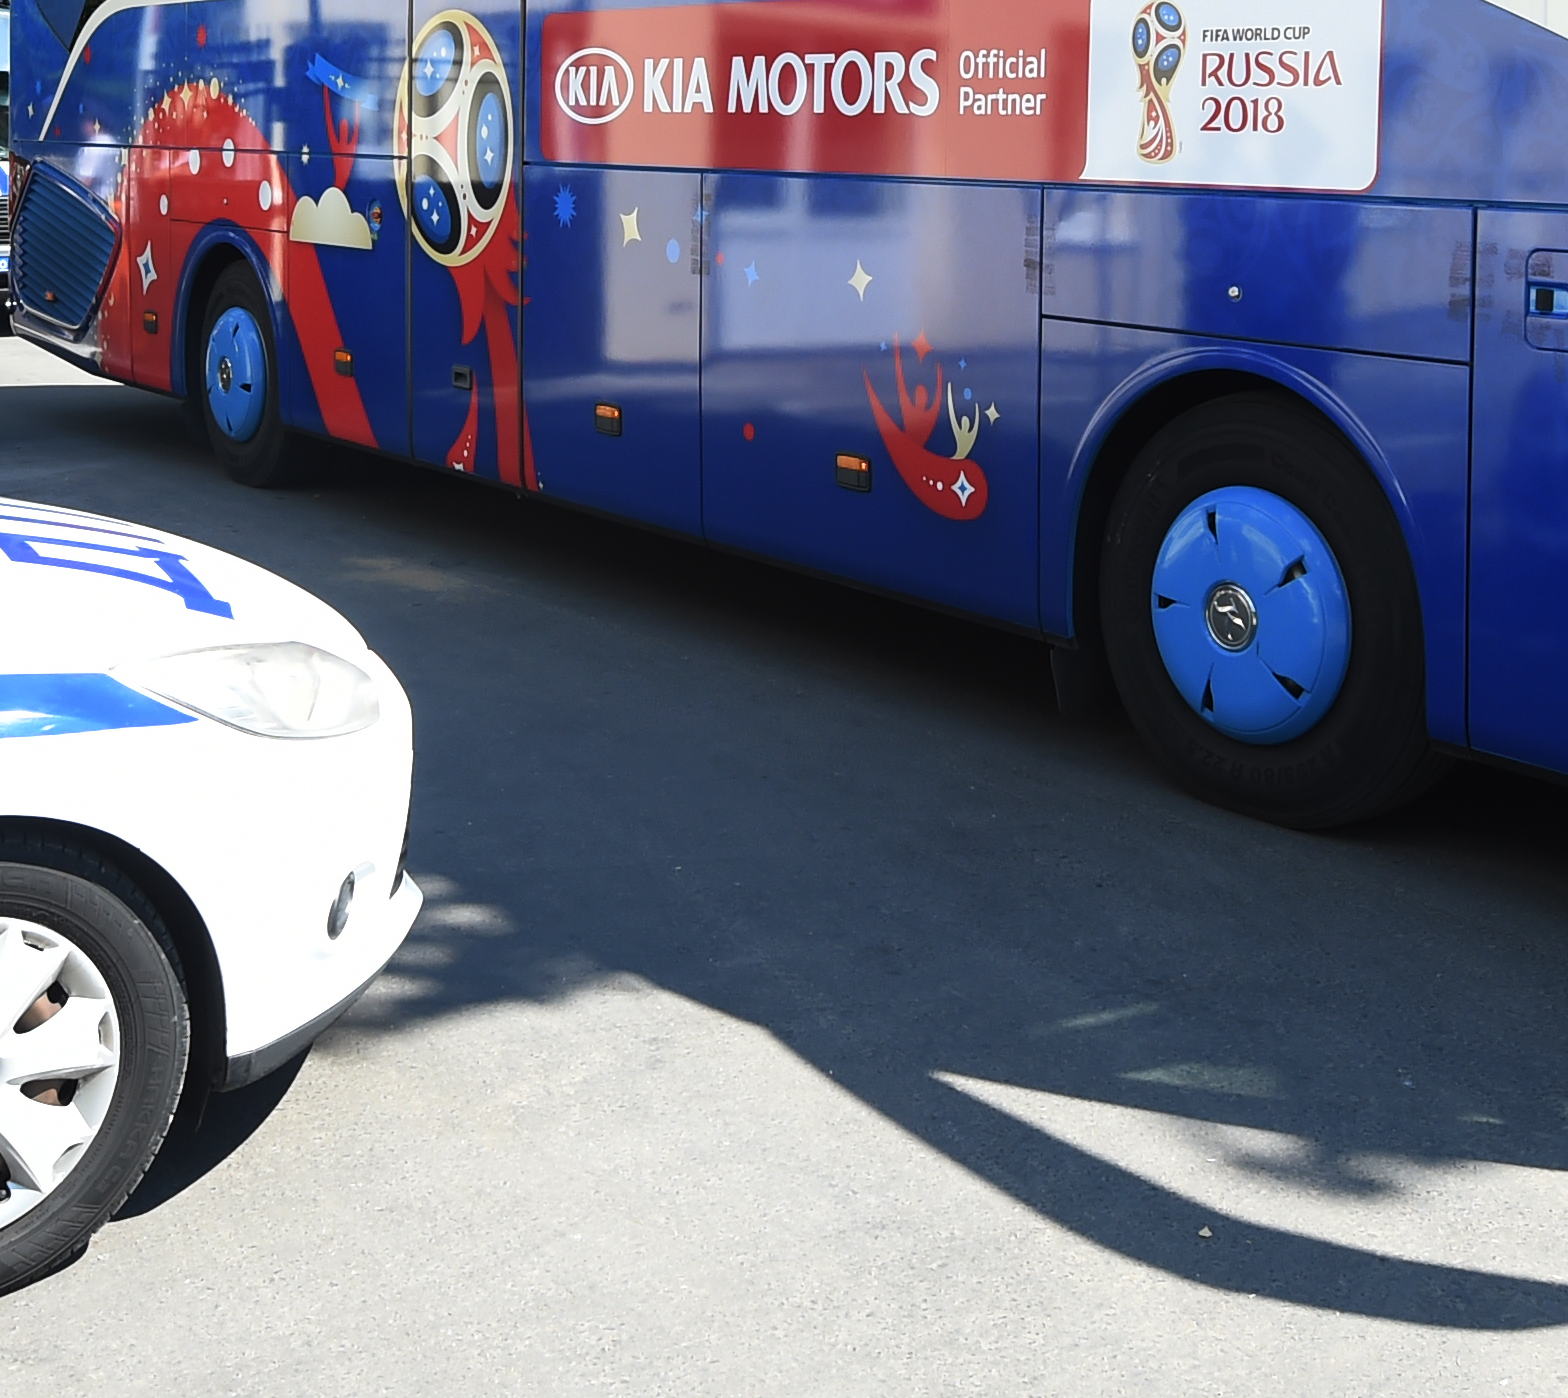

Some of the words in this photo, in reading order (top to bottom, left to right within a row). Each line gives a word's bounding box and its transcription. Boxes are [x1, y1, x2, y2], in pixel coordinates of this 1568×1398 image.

[1202, 29, 1230, 42] FIFA
[1232, 27, 1280, 41] WORLD
[1283, 26, 1310, 40] CUP
[643, 56, 713, 114] KIA
[728, 48, 941, 117] MOTORS
[959, 48, 1047, 81] Official
[1200, 50, 1342, 87] RUSSIA
[568, 66, 620, 107] KIA
[959, 87, 1047, 117] Partner
[1200, 96, 1284, 133] 2018
